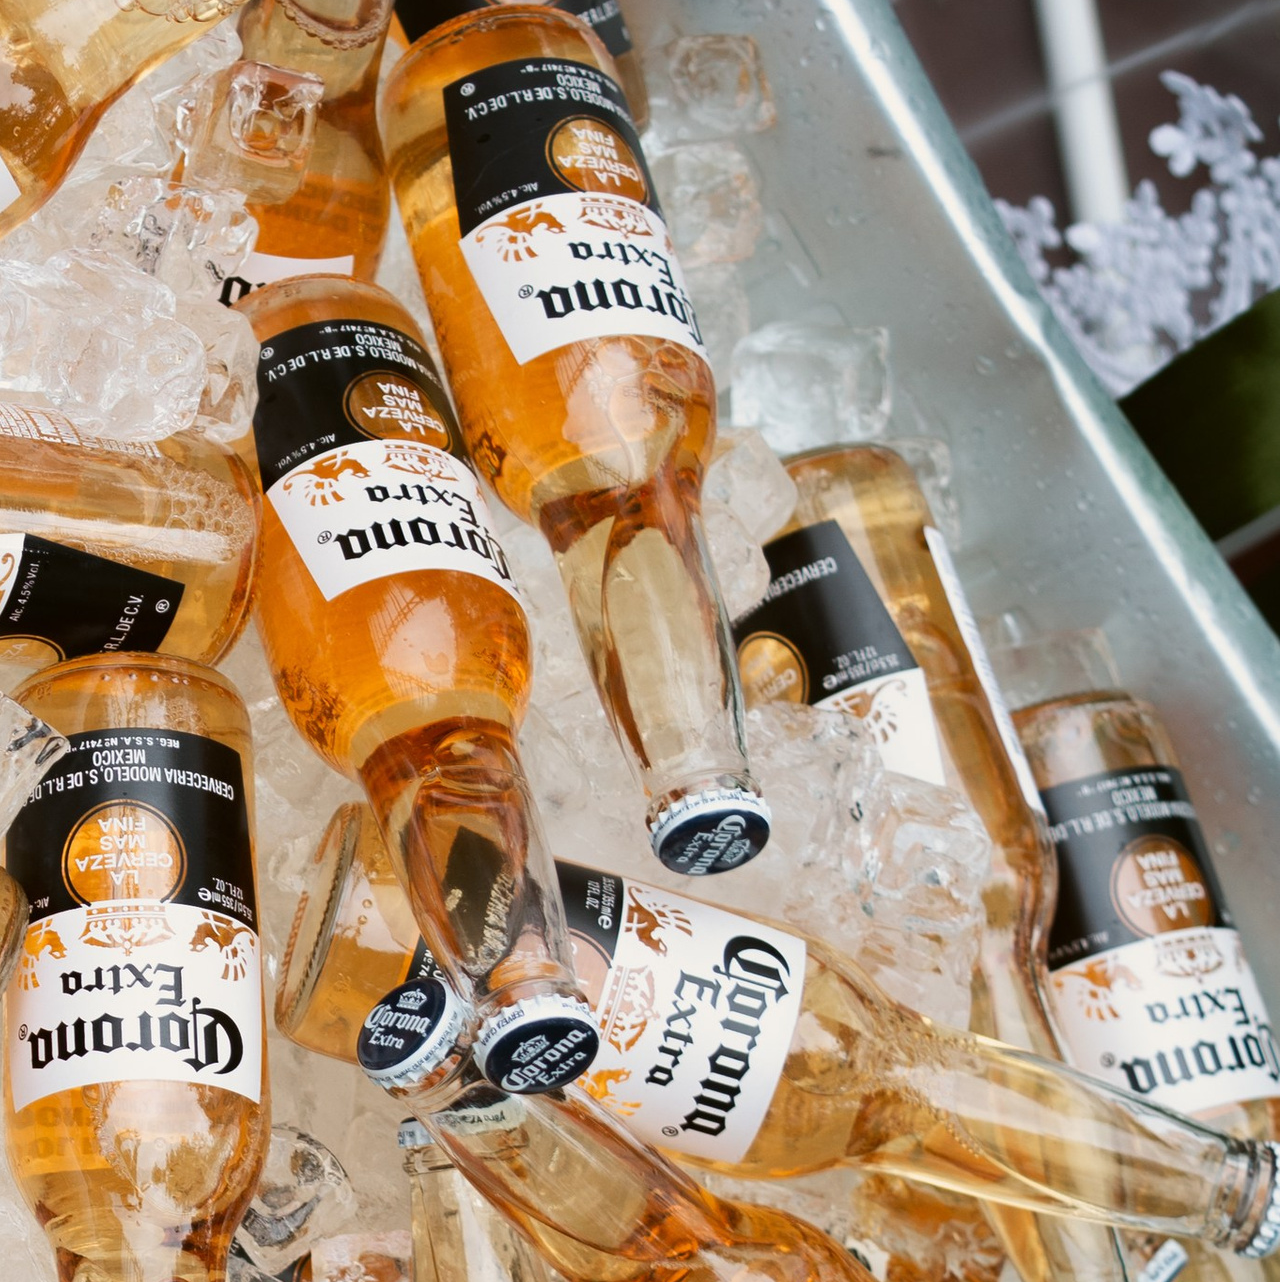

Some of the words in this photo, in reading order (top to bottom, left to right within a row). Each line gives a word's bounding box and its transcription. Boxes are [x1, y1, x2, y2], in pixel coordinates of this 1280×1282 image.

[534, 86, 553, 100] DE
[556, 73, 602, 94] MEXICO
[488, 95, 508, 111] DE
[506, 89, 534, 103] R.L.
[464, 101, 488, 121] C.V.
[572, 128, 614, 145] FINA
[578, 142, 618, 159] MAS
[558, 155, 638, 181] CERVEZA
[521, 181, 538, 193] Alc.
[594, 171, 620, 186] LA
[568, 242, 676, 290] Extra
[332, 345, 351, 359] DE
[354, 333, 402, 352] MEXICO
[287, 355, 306, 371] DE
[304, 348, 332, 363] R.L.
[268, 363, 287, 382] C.V.
[377, 383, 419, 399] FINA
[383, 395, 422, 412] MAS
[362, 403, 444, 433] CERVEZA
[398, 421, 425, 435] LA
[319, 433, 336, 444] Alc.
[365, 484, 478, 527] Extra
[8, 608, 24, 622] Alc.
[17, 579, 35, 605] 4.5%
[123, 594, 144, 615] C.V.
[115, 616, 135, 632] DE
[78, 738, 104, 751] 7417
[120, 736, 154, 747] S.S.A.
[155, 737, 180, 749] REG.
[92, 748, 146, 767] MEXICO
[66, 771, 84, 790] DE
[84, 768, 99, 785] S.
[100, 765, 162, 783] MODELO,
[42, 775, 64, 795] R.L.
[163, 767, 234, 801] CERVECERIA
[98, 817, 147, 831] FINA
[100, 835, 147, 850] MAS
[75, 852, 172, 871] CERVEZA
[110, 870, 139, 886] LA
[60, 964, 185, 1007] Extra
[1147, 988, 1250, 1025] Extra
[361, 1003, 432, 1033] Corona
[28, 997, 243, 1074] Corona
[645, 971, 721, 1086] Extra
[680, 936, 790, 1136] Corona
[368, 1028, 405, 1049] Extra
[500, 1029, 592, 1092] Corona
[536, 1051, 587, 1086] Extra
